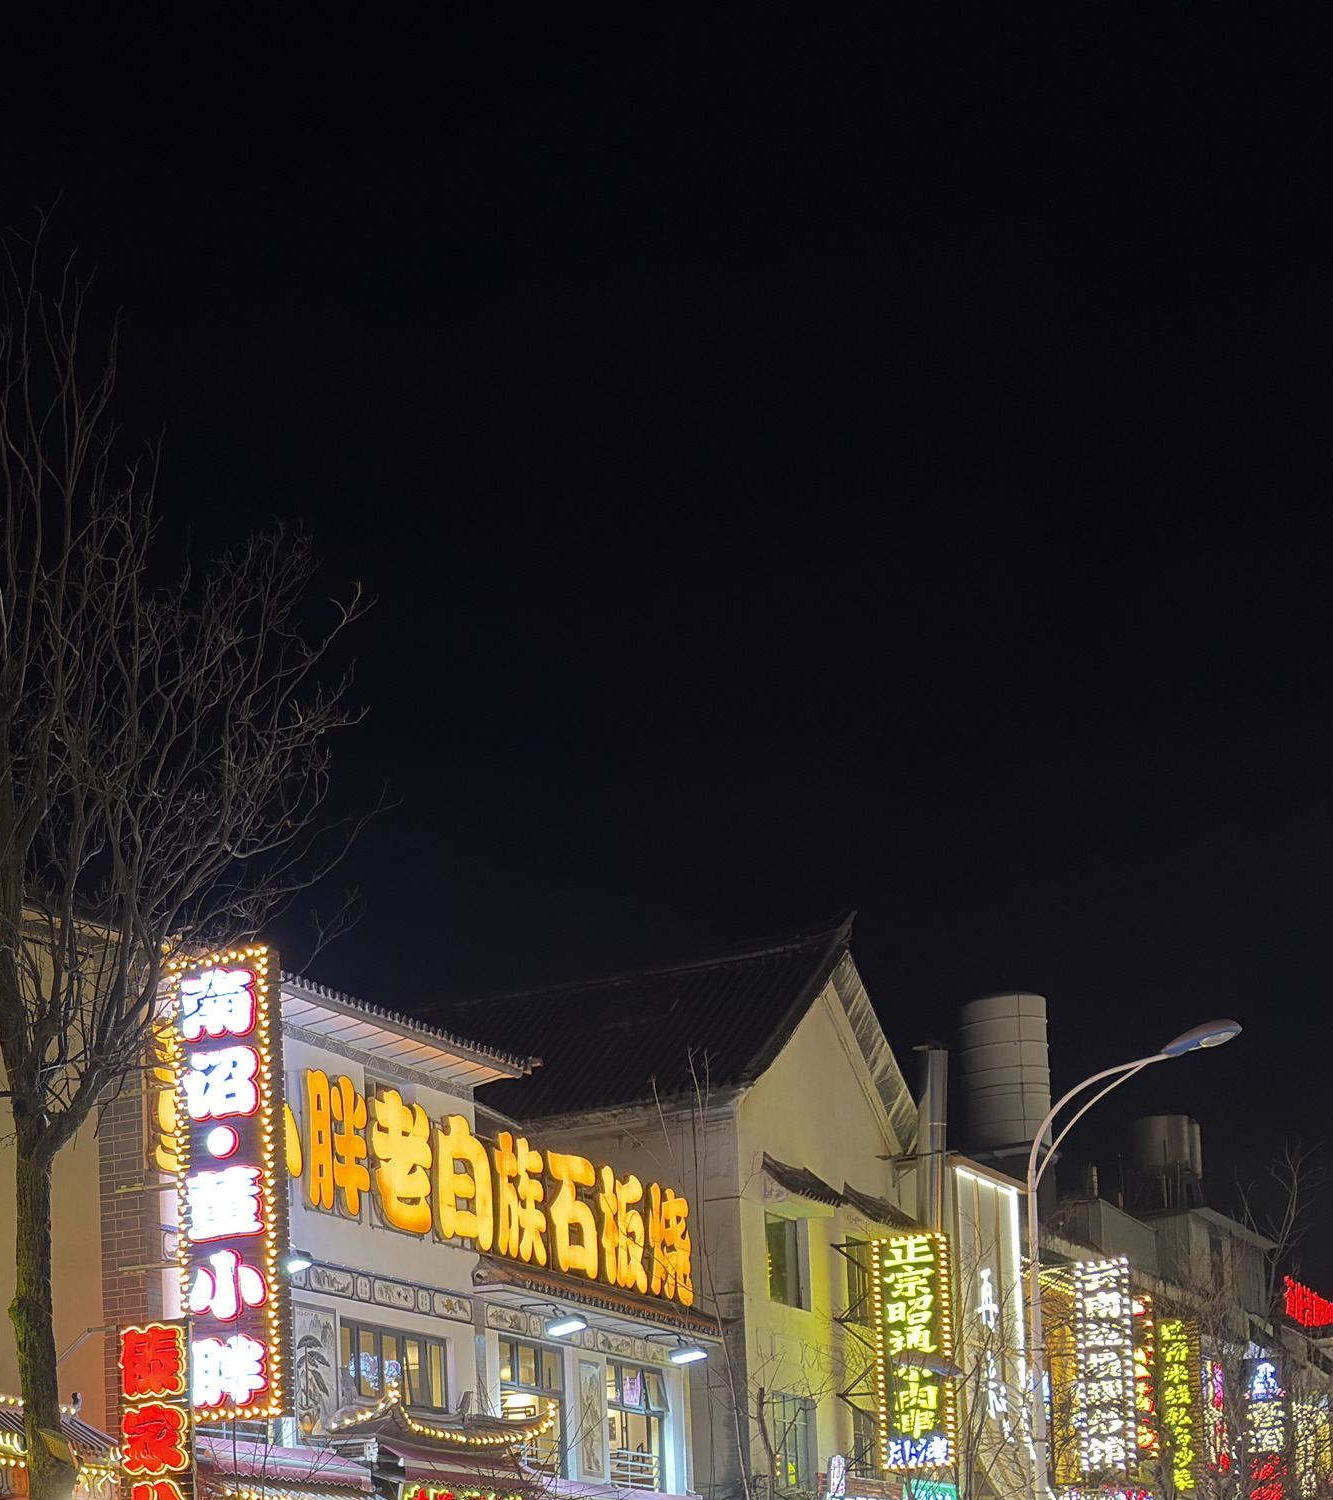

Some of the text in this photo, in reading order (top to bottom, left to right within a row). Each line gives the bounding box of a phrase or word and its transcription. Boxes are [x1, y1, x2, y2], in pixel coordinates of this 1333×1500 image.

[283, 1067, 694, 1306] 胖老白族石板烧
